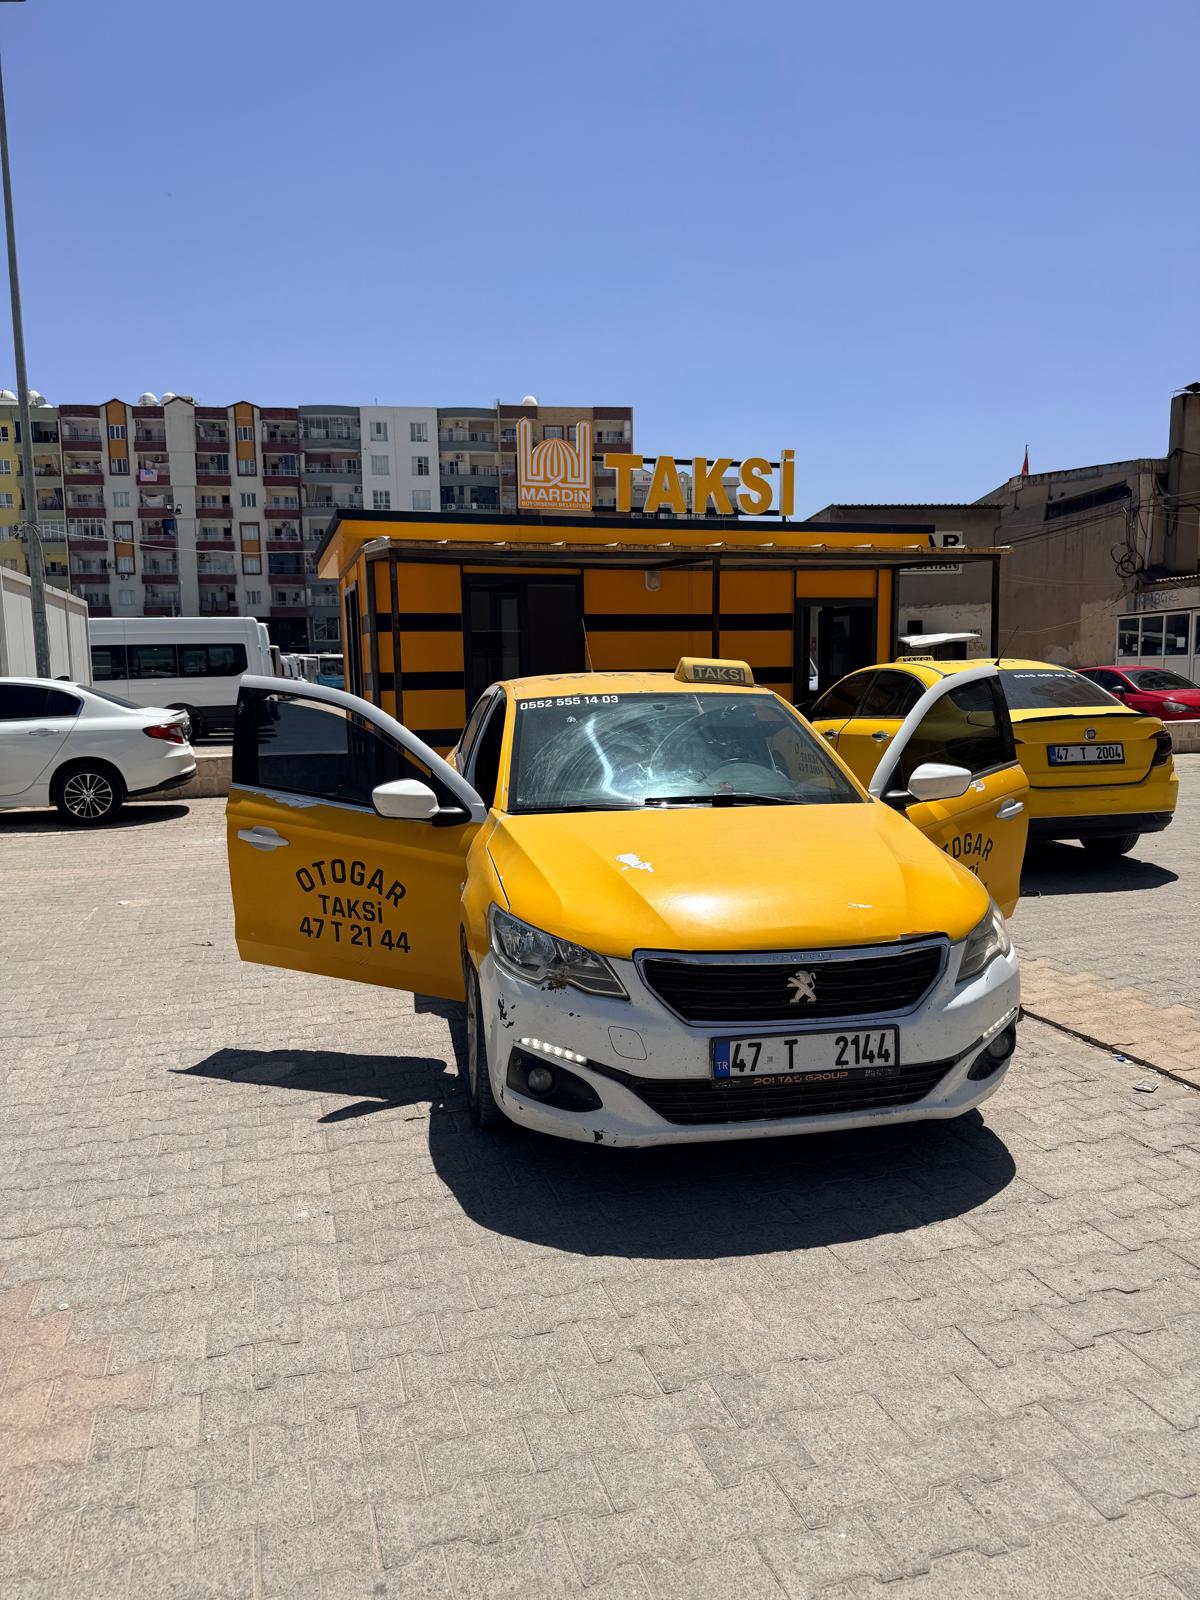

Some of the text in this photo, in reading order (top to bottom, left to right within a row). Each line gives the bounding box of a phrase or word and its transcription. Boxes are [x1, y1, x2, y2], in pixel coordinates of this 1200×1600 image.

[520, 694, 619, 710] 0552 555 14 03
[1056, 747, 1069, 761] 47
[1079, 747, 1086, 760] T
[1096, 746, 1121, 760] 2004
[942, 832, 994, 861] OGAR
[295, 858, 407, 908] OTOGAR
[299, 916, 411, 953] 47 T 21 44
[717, 1032, 891, 1072] TR 47 T 2144
[805, 1071, 849, 1082] GROUP
